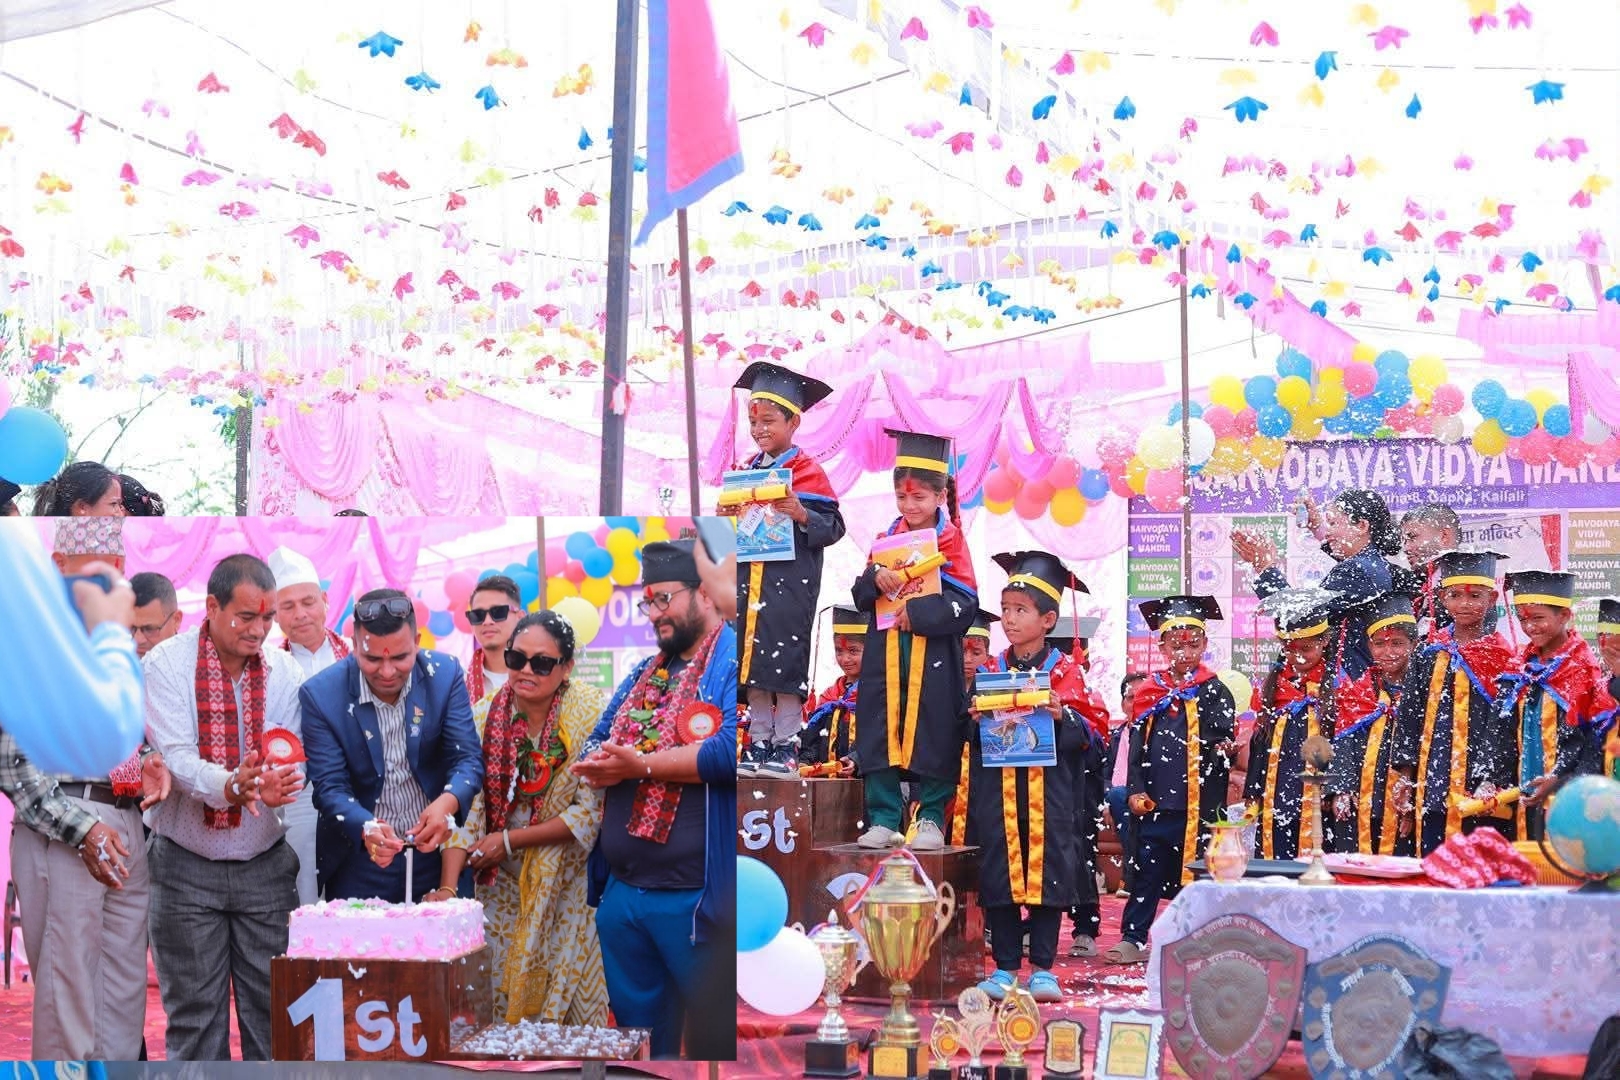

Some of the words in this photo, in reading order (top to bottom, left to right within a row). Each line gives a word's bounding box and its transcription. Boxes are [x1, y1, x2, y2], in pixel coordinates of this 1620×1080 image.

[1406, 446, 1512, 486] VIDYA
[1568, 519, 1620, 528] SARVODAYA
[1131, 525, 1179, 533] SARVODAYA
[1578, 529, 1605, 538] VIDYA
[1140, 534, 1165, 543] VIDYA
[1575, 539, 1612, 548] MANDIR
[1138, 544, 1171, 553] MANDIR
[1131, 563, 1179, 572] SARVODAYA
[1568, 560, 1620, 569] SARVODAYA
[1140, 573, 1166, 581] VIDYA
[1577, 571, 1605, 580] VIDYA
[1574, 581, 1612, 590] MANDIR
[287, 978, 428, 1061] 1st
